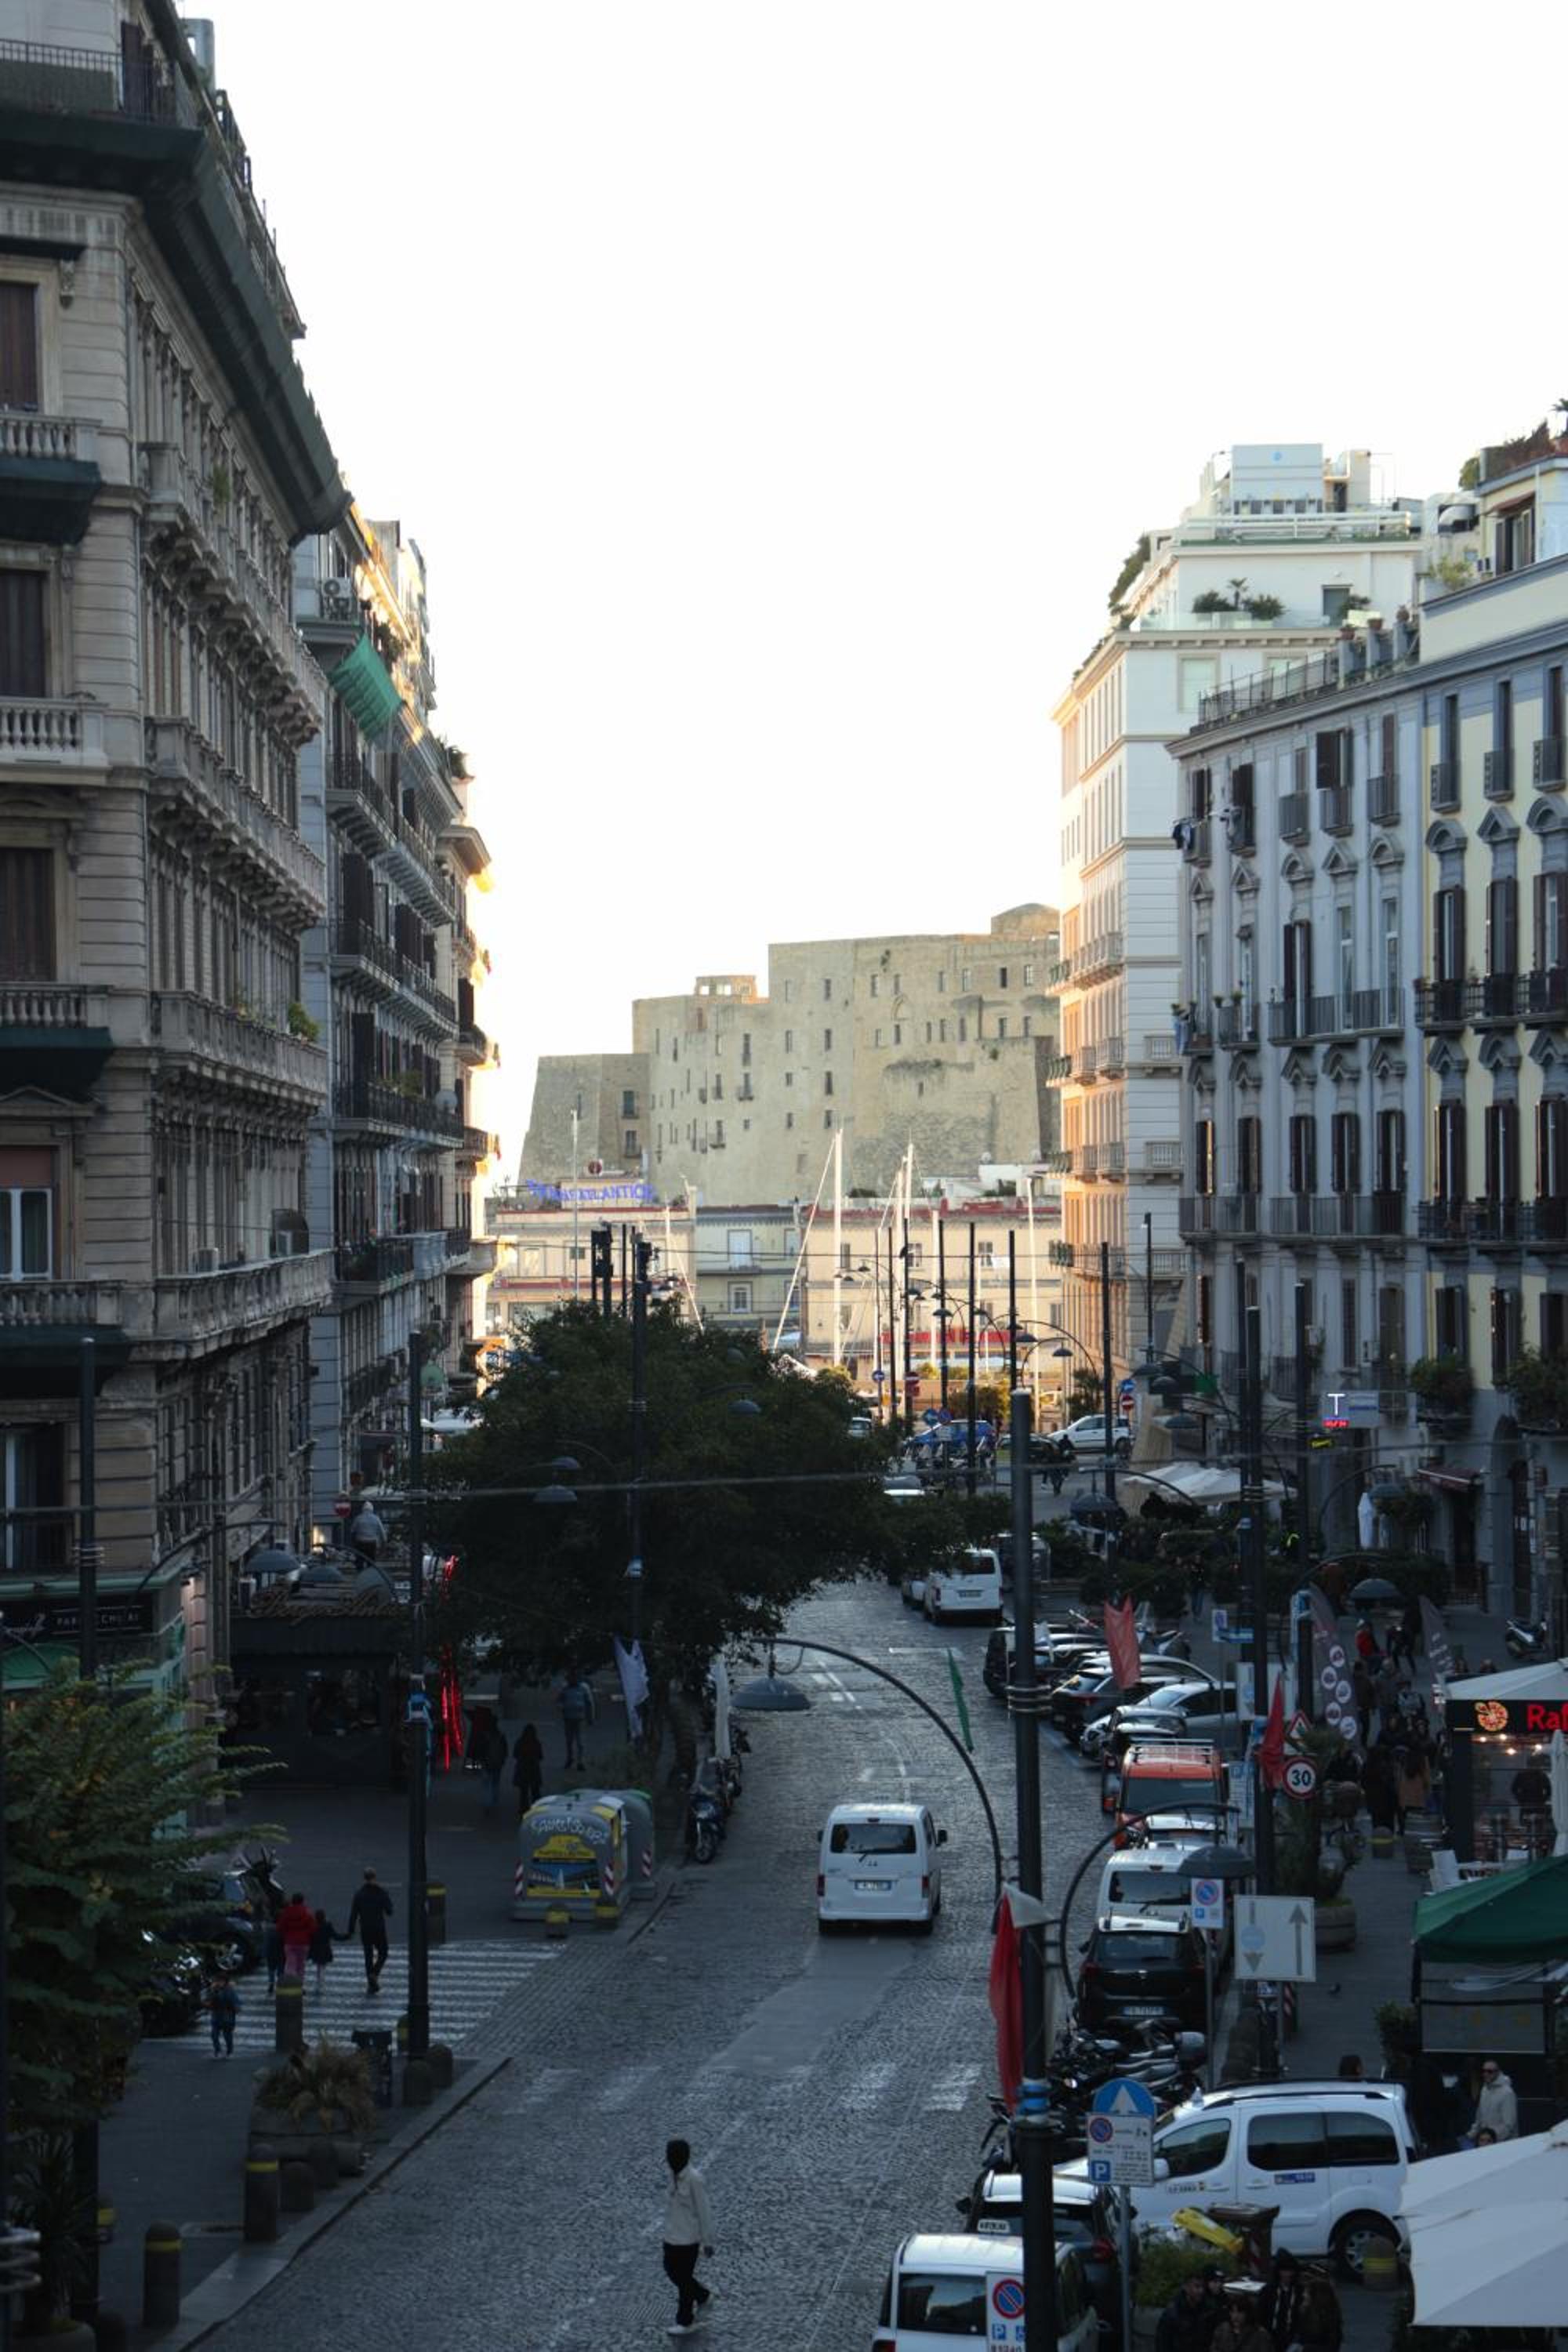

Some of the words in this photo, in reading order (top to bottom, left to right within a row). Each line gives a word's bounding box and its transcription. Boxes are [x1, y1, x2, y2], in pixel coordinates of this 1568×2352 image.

[1292, 1769, 1311, 1786] 30
[1094, 2162, 1107, 2180] P
[994, 2325, 1004, 2339] P
